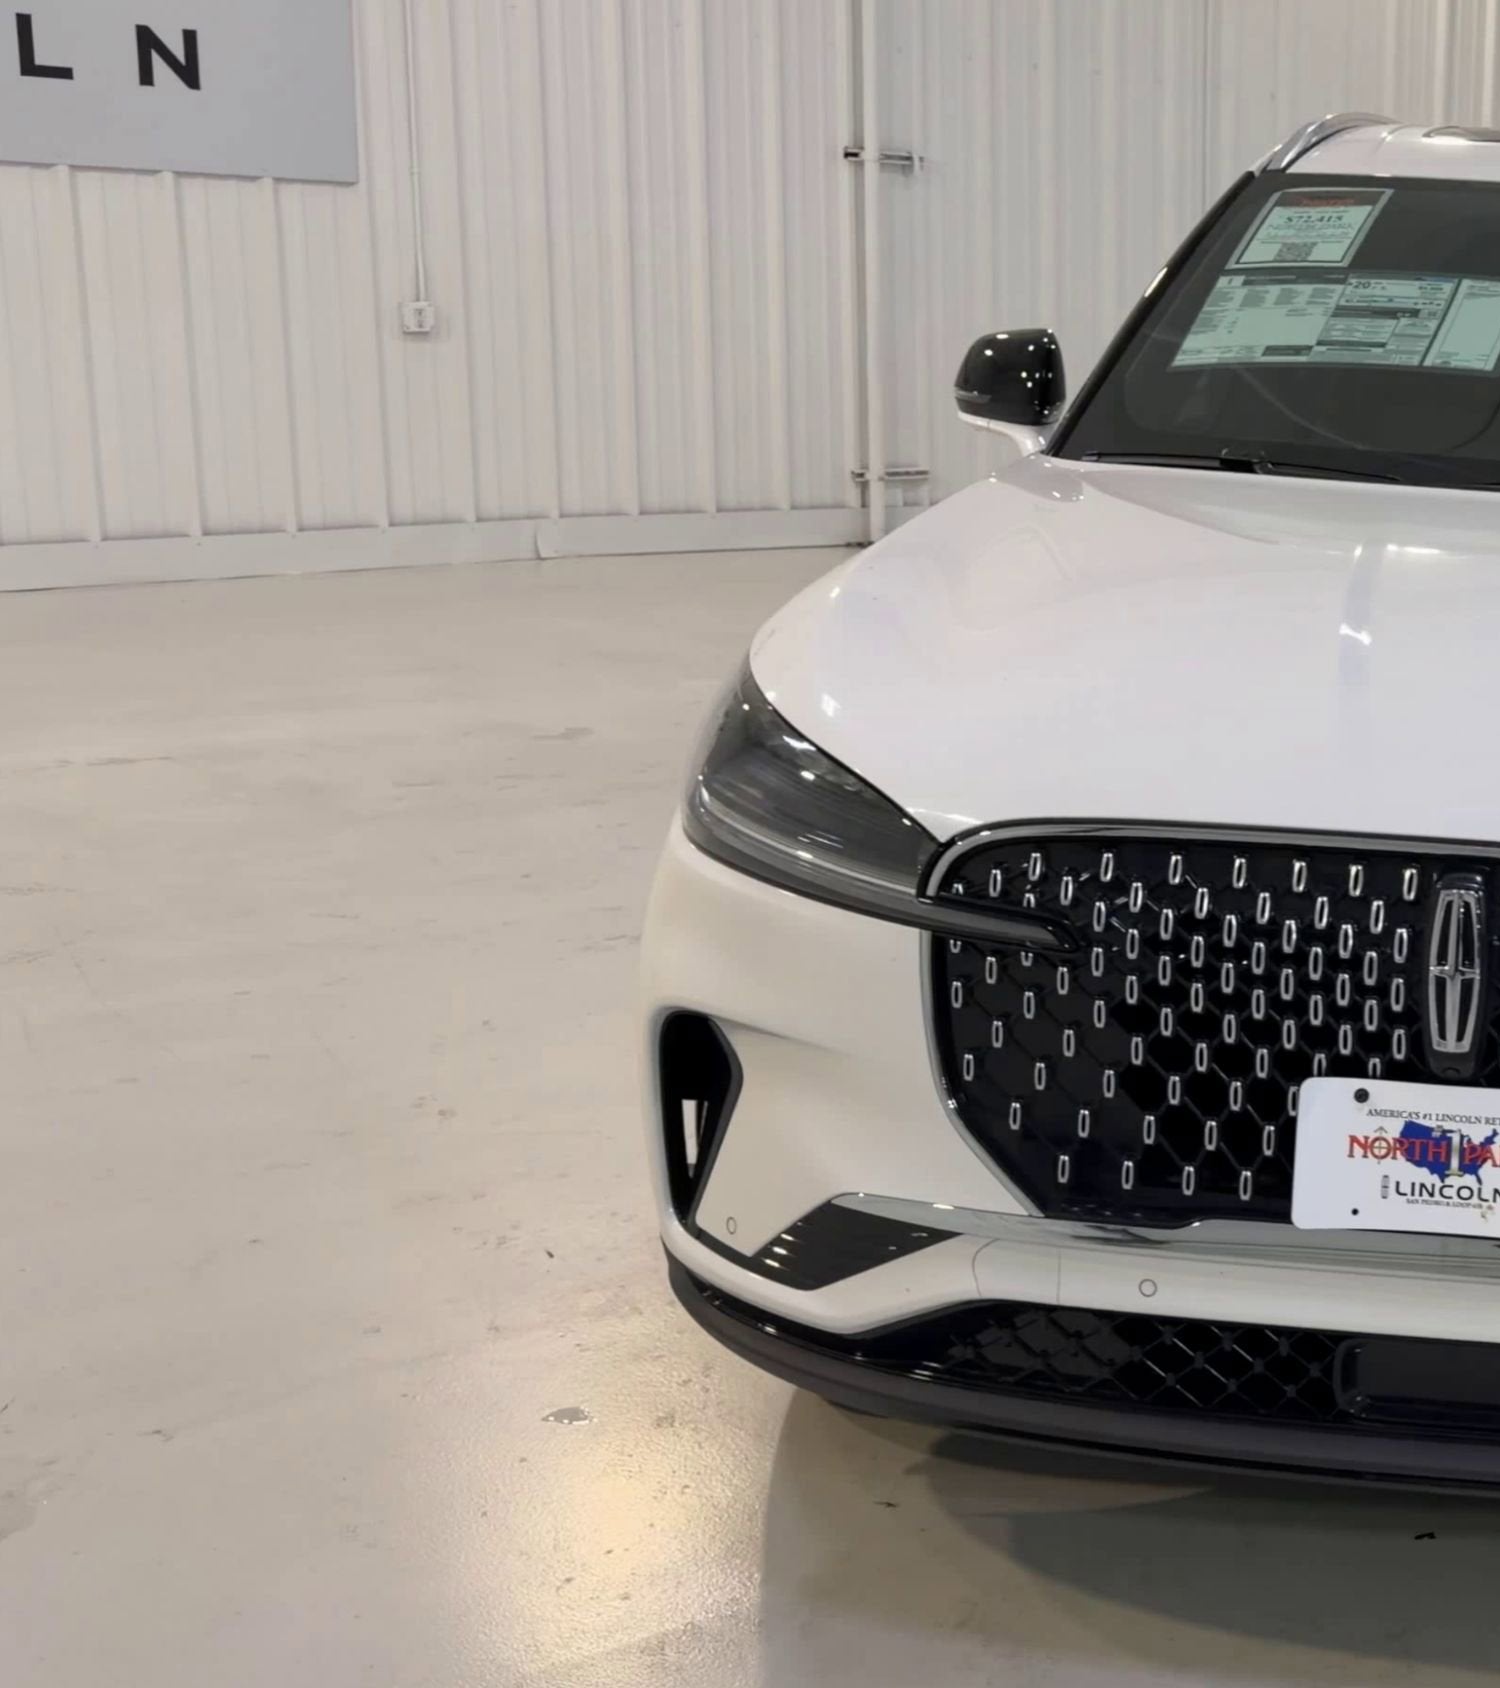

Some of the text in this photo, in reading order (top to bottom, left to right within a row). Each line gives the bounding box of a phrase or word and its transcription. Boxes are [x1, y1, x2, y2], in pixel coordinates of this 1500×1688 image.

[1366, 1108, 1421, 1120] AMERICA'S
[1435, 1113, 1482, 1125] LINCOLN
[1347, 1134, 1449, 1162] NORTH
